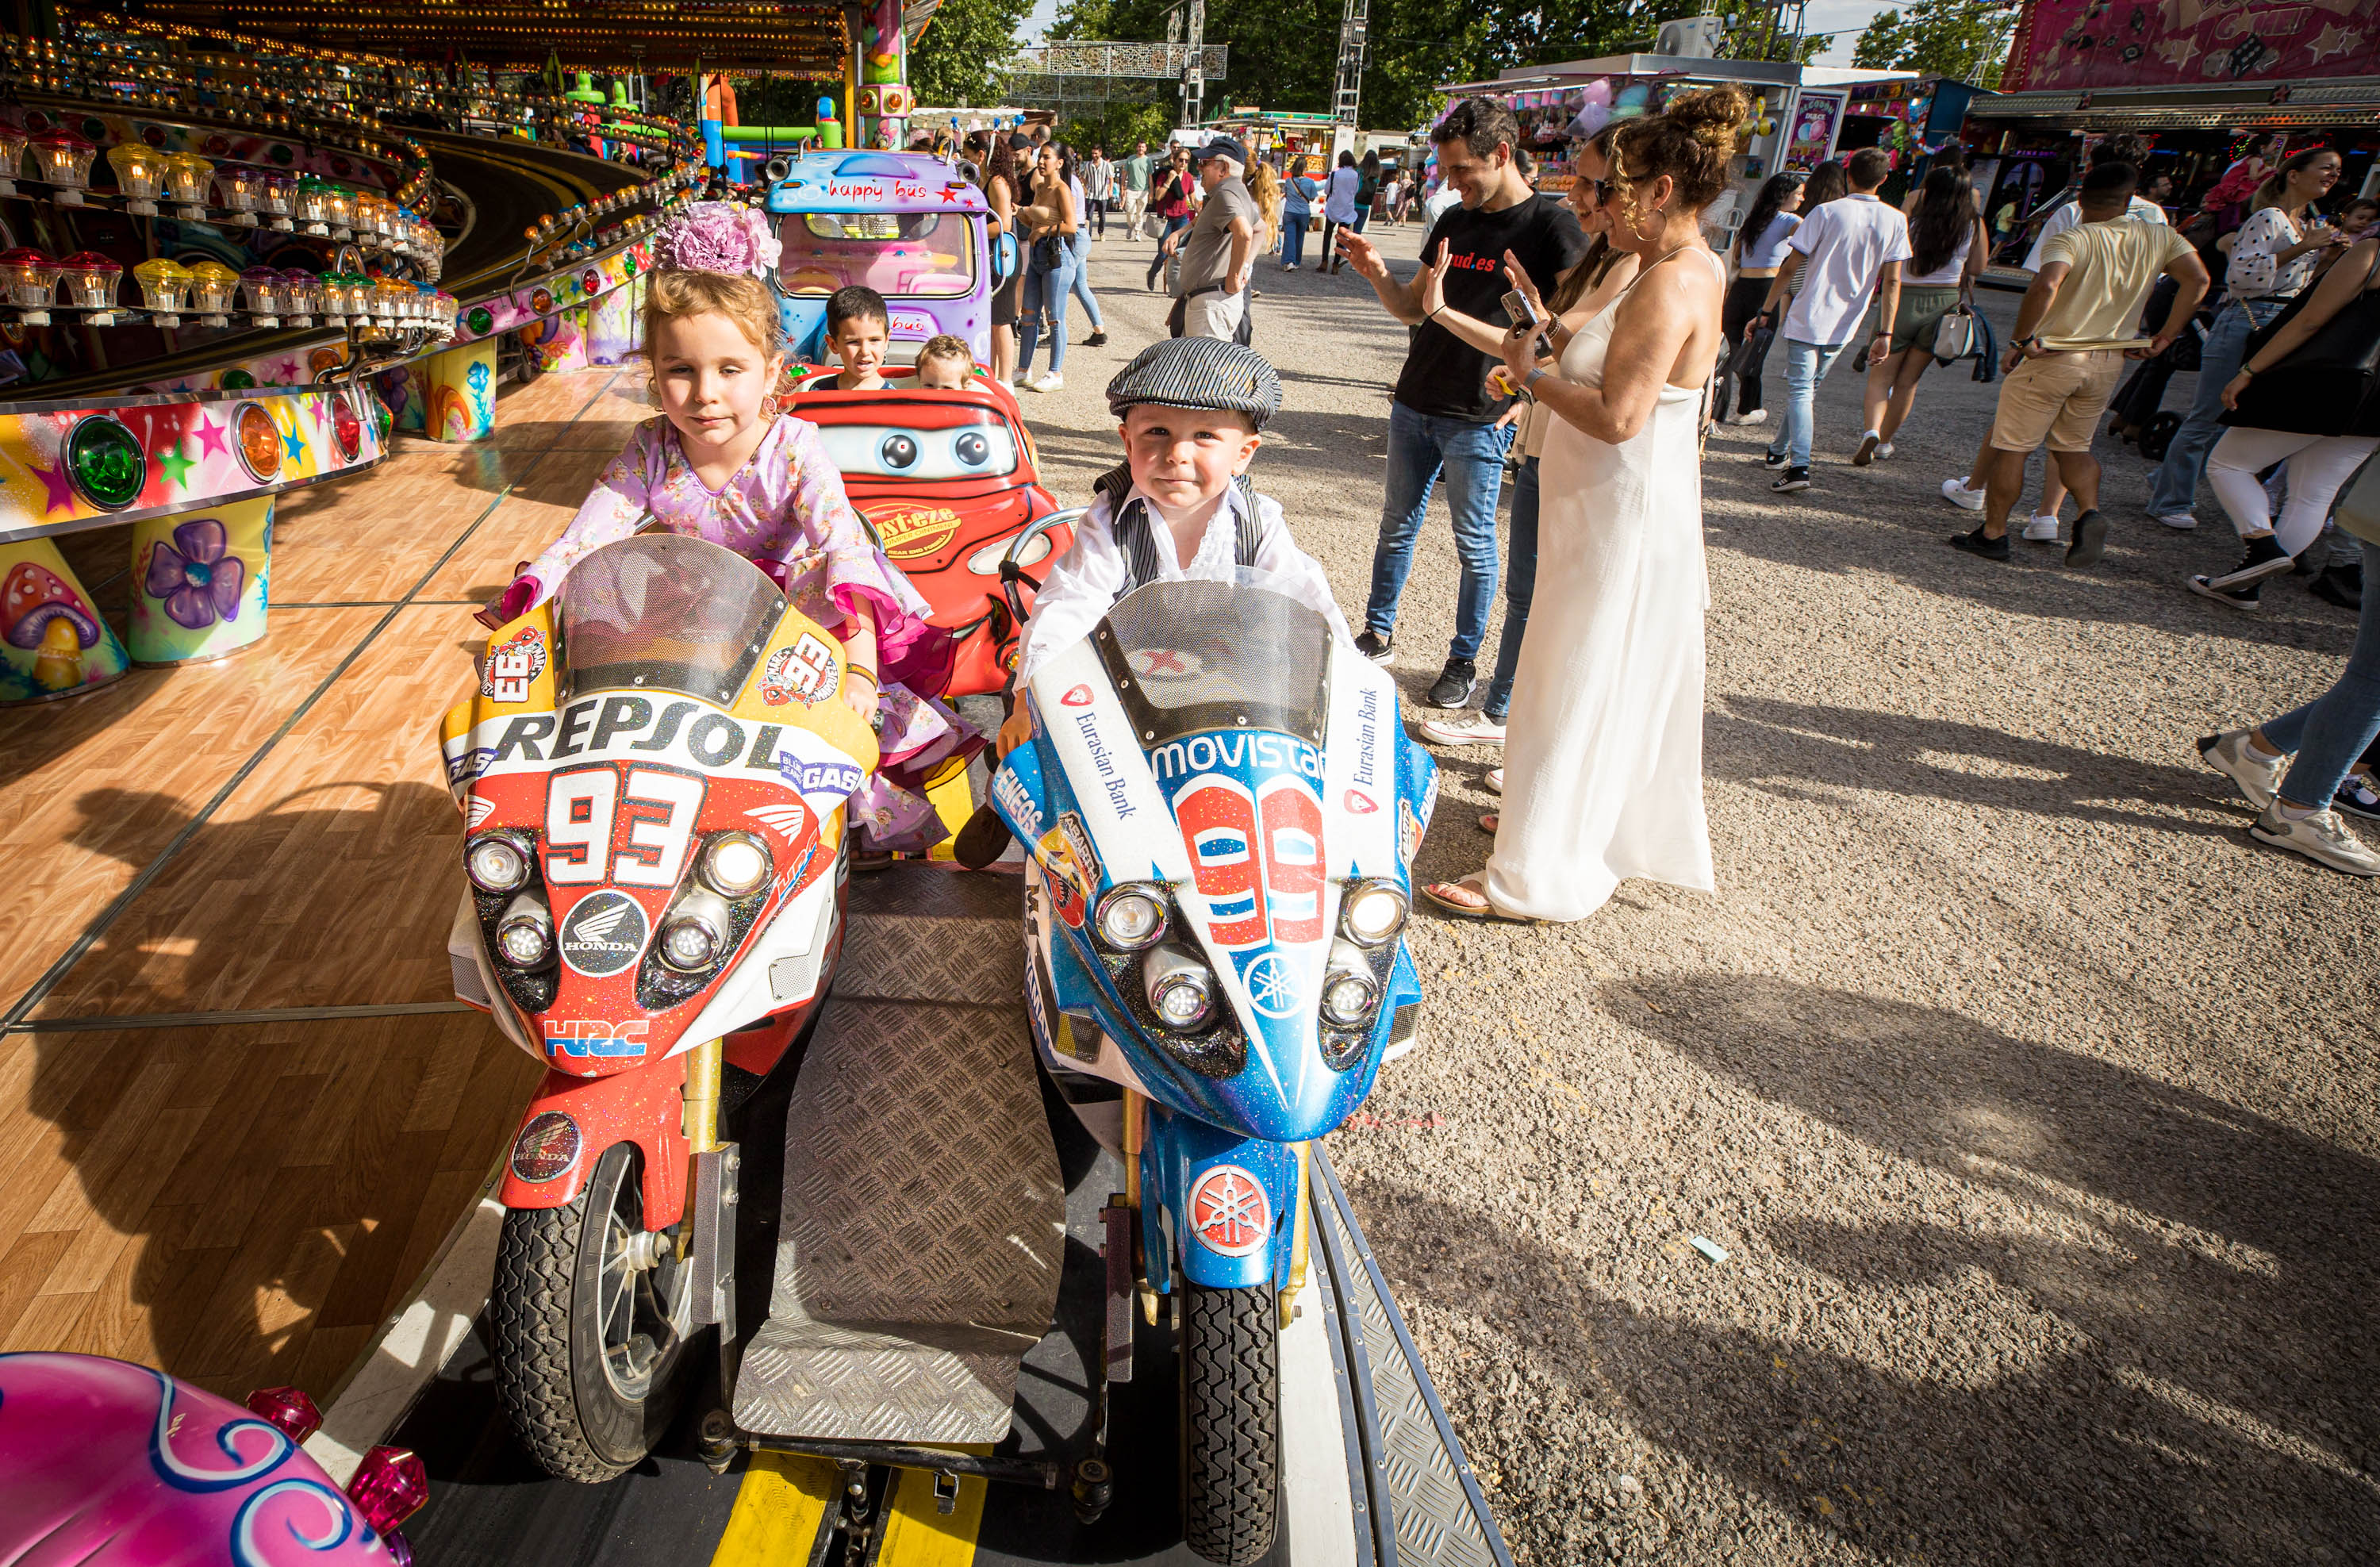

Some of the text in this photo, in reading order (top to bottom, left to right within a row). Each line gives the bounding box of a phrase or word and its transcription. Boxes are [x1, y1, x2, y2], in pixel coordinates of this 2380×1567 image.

[829, 180, 927, 202] happy bus
[1449, 252, 1496, 271] ud.es
[892, 317, 924, 332] bus
[884, 522, 953, 546] UMPER OINTMENT
[530, 647, 546, 673] MARC
[767, 651, 788, 677] MARC
[782, 632, 832, 695] 93
[493, 653, 530, 703] 93
[493, 696, 784, 770] REPSOL
[1353, 688, 1377, 786] Eurasian Bank
[448, 753, 495, 783] GAS
[782, 756, 803, 774] BLUE
[1076, 712, 1137, 820] Eurasian Bank
[803, 767, 859, 792] GAS
[996, 766, 1043, 835] ENEOS
[544, 760, 708, 889] 93
[563, 941, 639, 952] HONDA
[544, 1020, 649, 1057] HRC
[514, 1152, 571, 1162] HONDA
